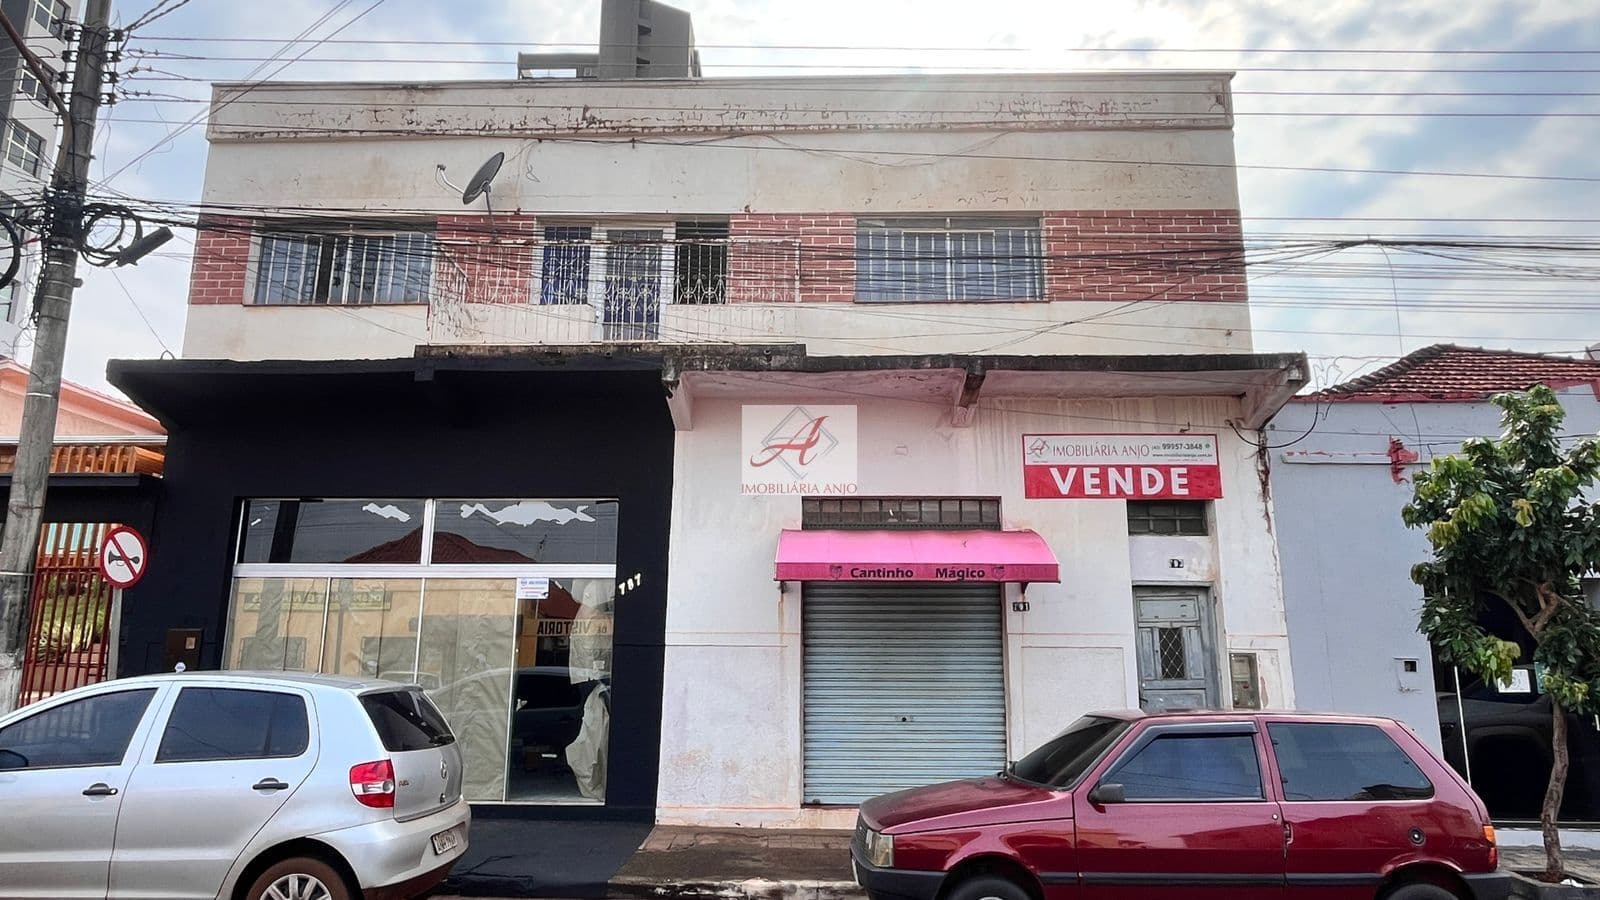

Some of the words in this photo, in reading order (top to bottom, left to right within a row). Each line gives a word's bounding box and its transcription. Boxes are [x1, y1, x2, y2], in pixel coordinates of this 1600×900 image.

[1053, 442, 1118, 457] IMOBILIÁRIA
[1122, 444, 1150, 458] ANJO
[1049, 467, 1190, 496] VENDE
[850, 567, 914, 579] Cantinho
[935, 566, 986, 581] Mágico
